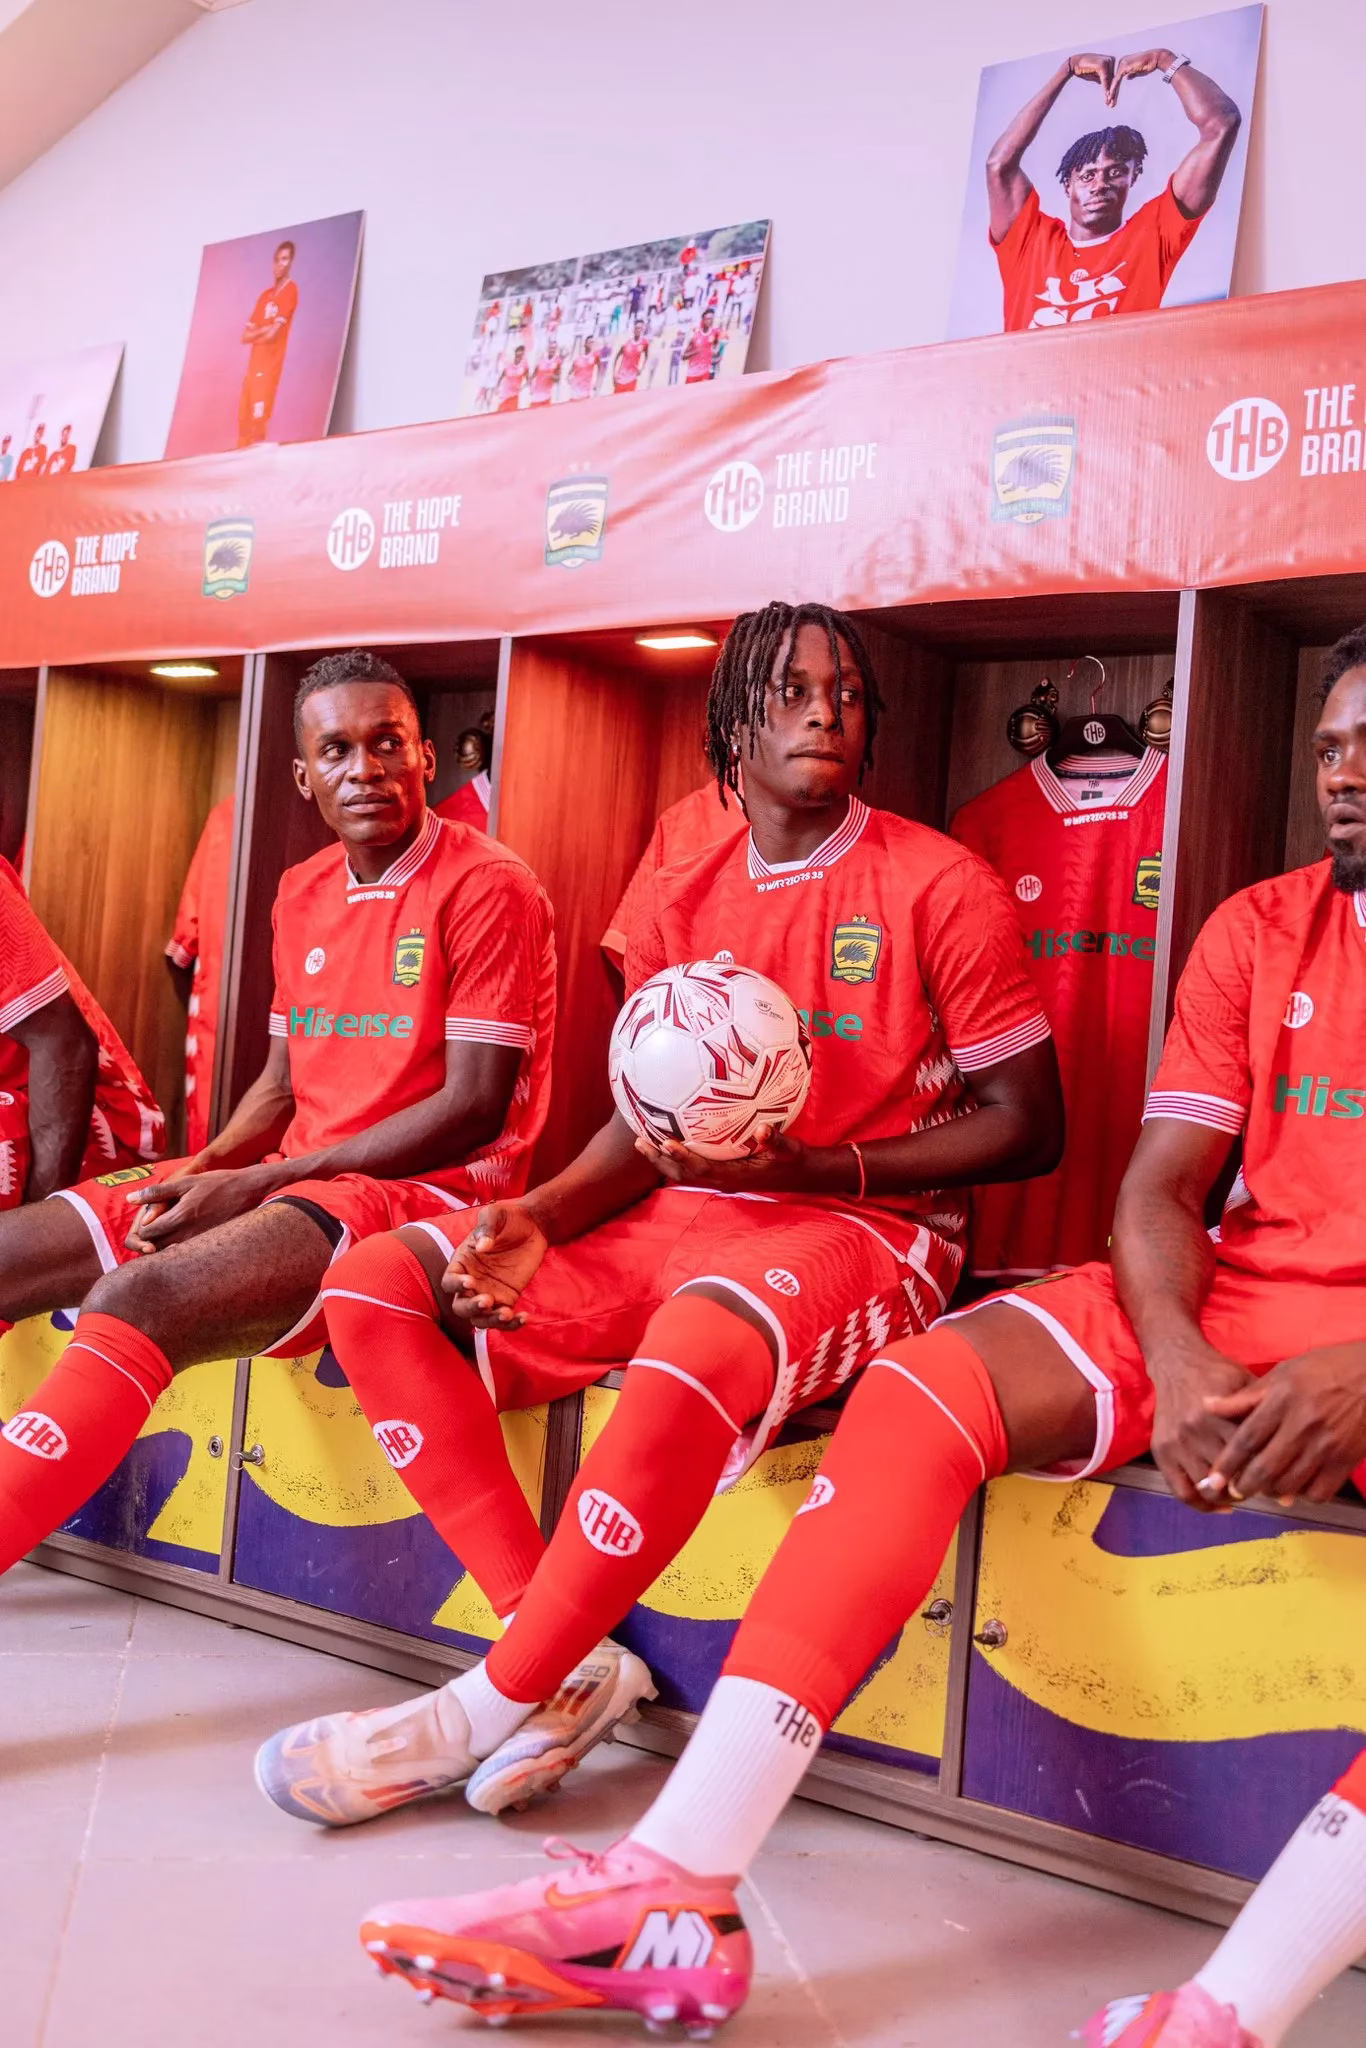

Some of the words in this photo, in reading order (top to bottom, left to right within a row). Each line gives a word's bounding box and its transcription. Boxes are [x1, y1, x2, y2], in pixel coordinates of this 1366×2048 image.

[1303, 383, 1357, 431] THE
[1211, 405, 1285, 474] THB
[1300, 429, 1366, 477] BRA
[775, 450, 813, 490] THE
[819, 442, 878, 485] HOPE
[383, 500, 413, 534] THE
[416, 495, 462, 530] HOPE
[706, 466, 764, 527] THB
[773, 486, 850, 529] BRAND
[75, 535, 100, 566] THE
[101, 530, 139, 563] HOPE
[331, 512, 373, 566] THB
[378, 531, 440, 569] BRAND
[32, 545, 67, 593] THB
[70, 563, 121, 597] BRAND
[1084, 723, 1105, 743] THB
[766, 872, 811, 891] WARRIORS
[811, 871, 824, 879] 35
[1017, 877, 1041, 900] THB
[290, 1005, 414, 1039] Hisense
[769, 1269, 798, 1296] THB
[8, 1415, 64, 1457] THB
[584, 1493, 637, 1551] THB
[774, 1700, 816, 1748] THB
